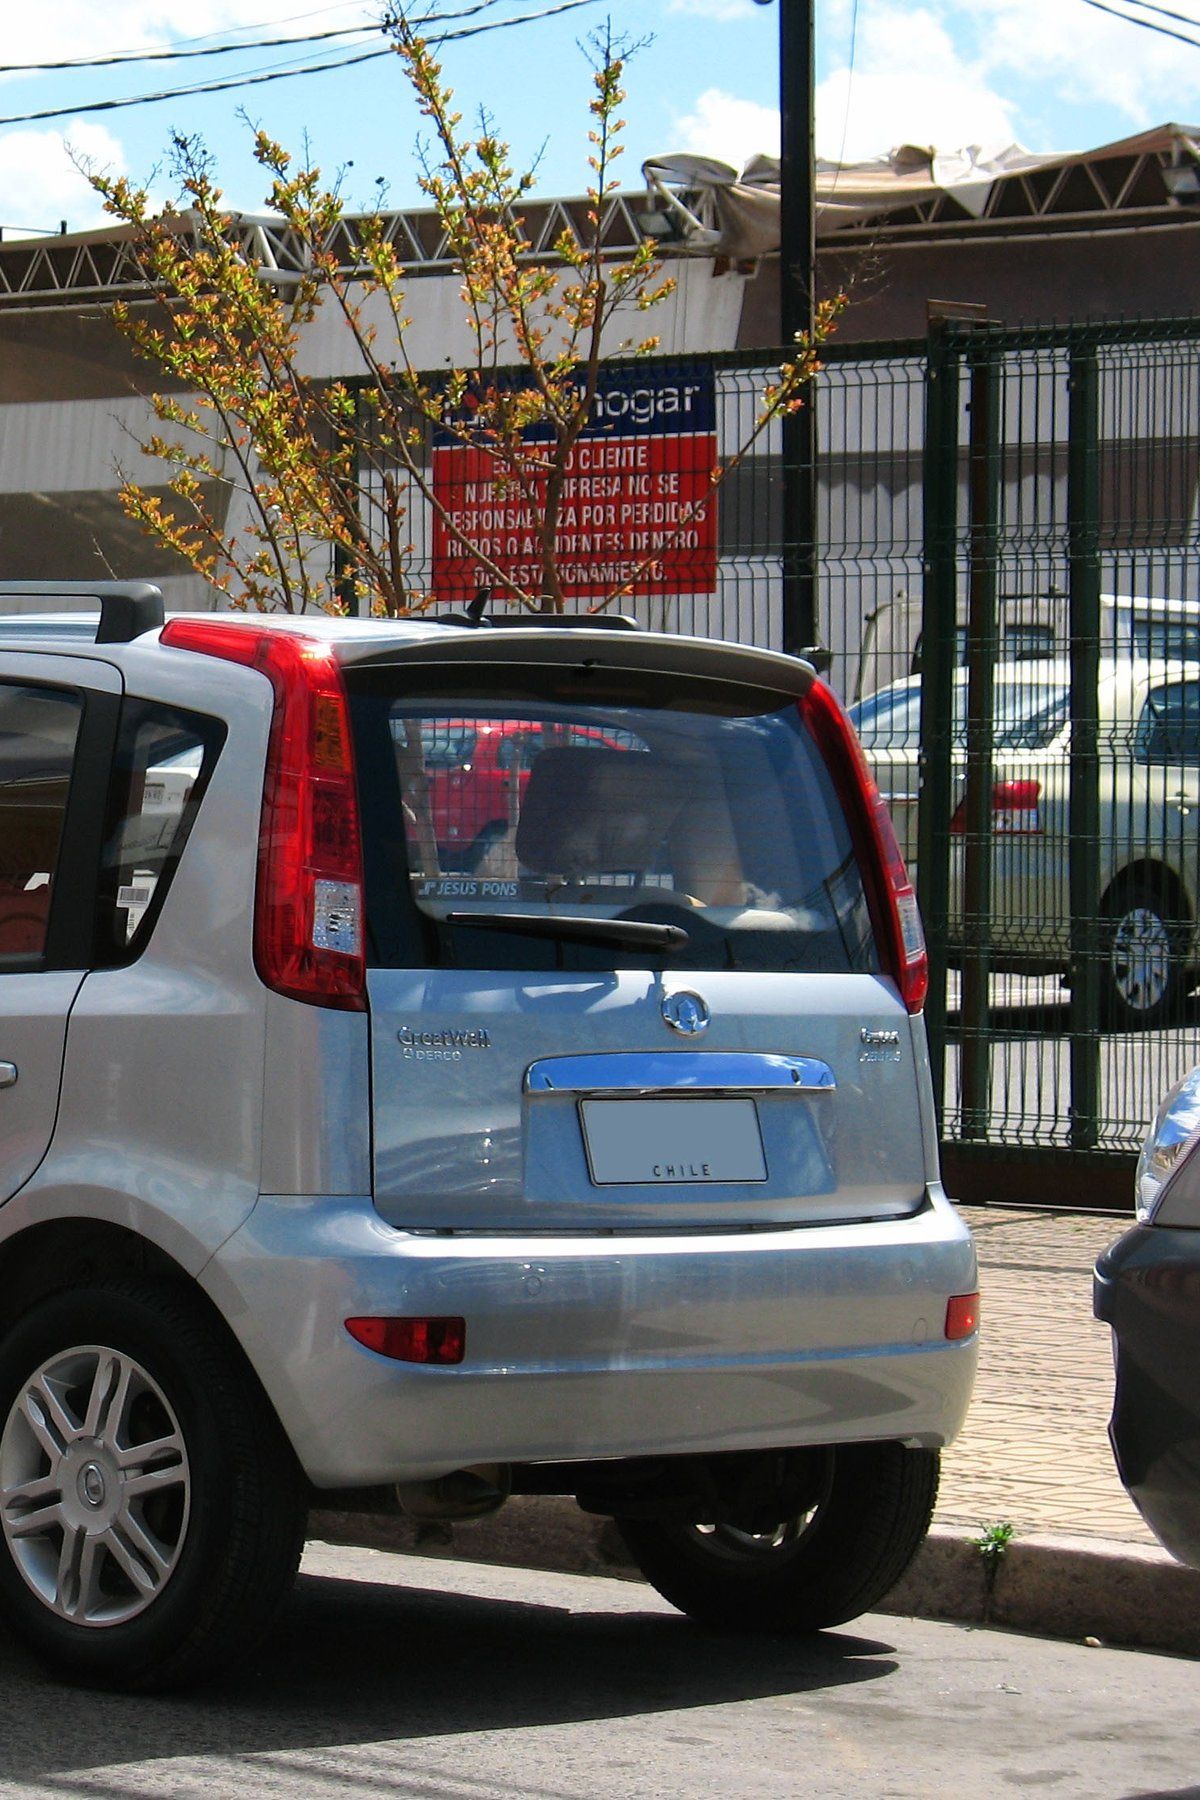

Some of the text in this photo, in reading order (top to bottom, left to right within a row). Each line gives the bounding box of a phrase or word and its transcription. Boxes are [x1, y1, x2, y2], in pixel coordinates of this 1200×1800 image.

[579, 445, 648, 470] CLIENTE
[657, 472, 680, 495] SE
[581, 504, 616, 527] POR
[436, 881, 519, 897] JESUS PONS
[653, 1164, 711, 1177] CHILE
